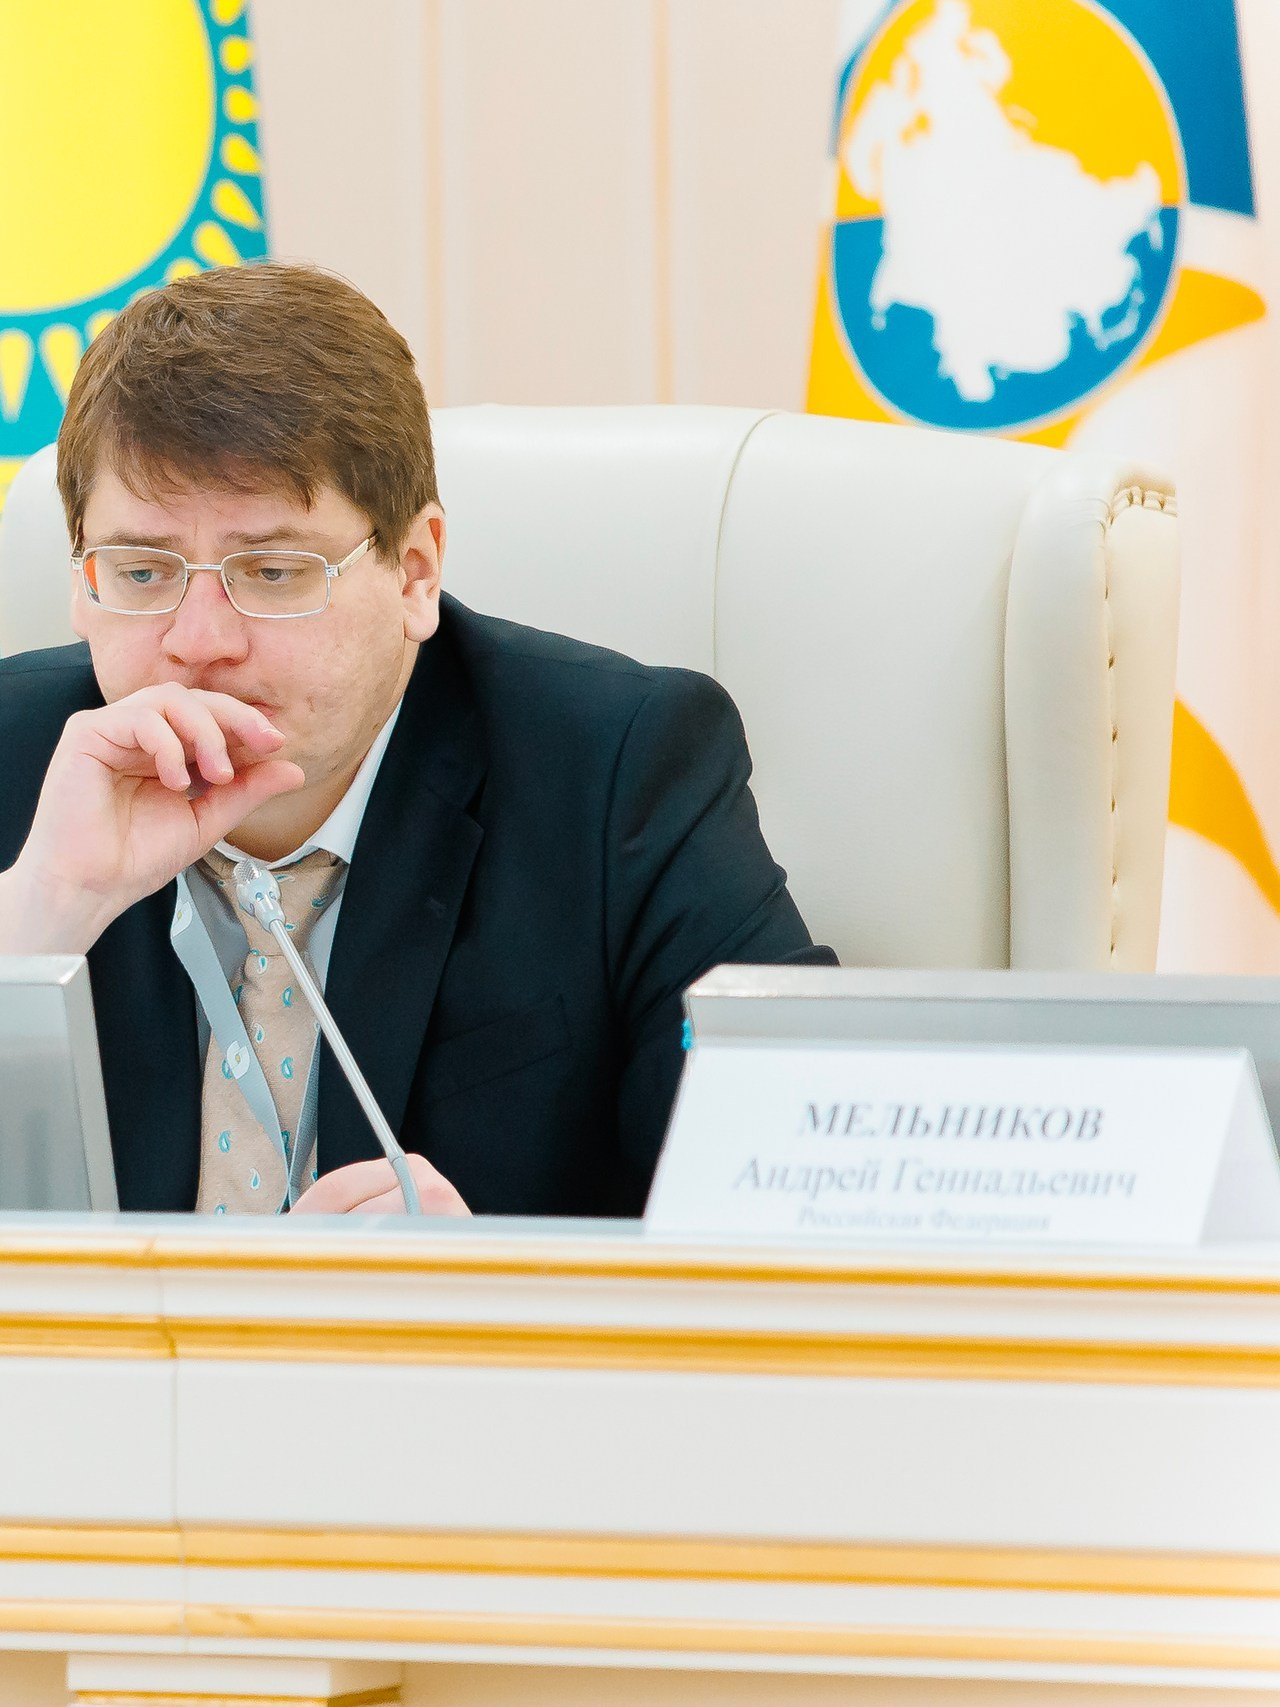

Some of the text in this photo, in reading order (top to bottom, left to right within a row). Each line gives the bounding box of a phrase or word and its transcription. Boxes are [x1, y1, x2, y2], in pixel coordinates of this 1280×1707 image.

[797, 1101, 1105, 1142] МЕЛЬНИКОВ
[732, 1156, 1138, 1202] Андрей Геннадьевич
